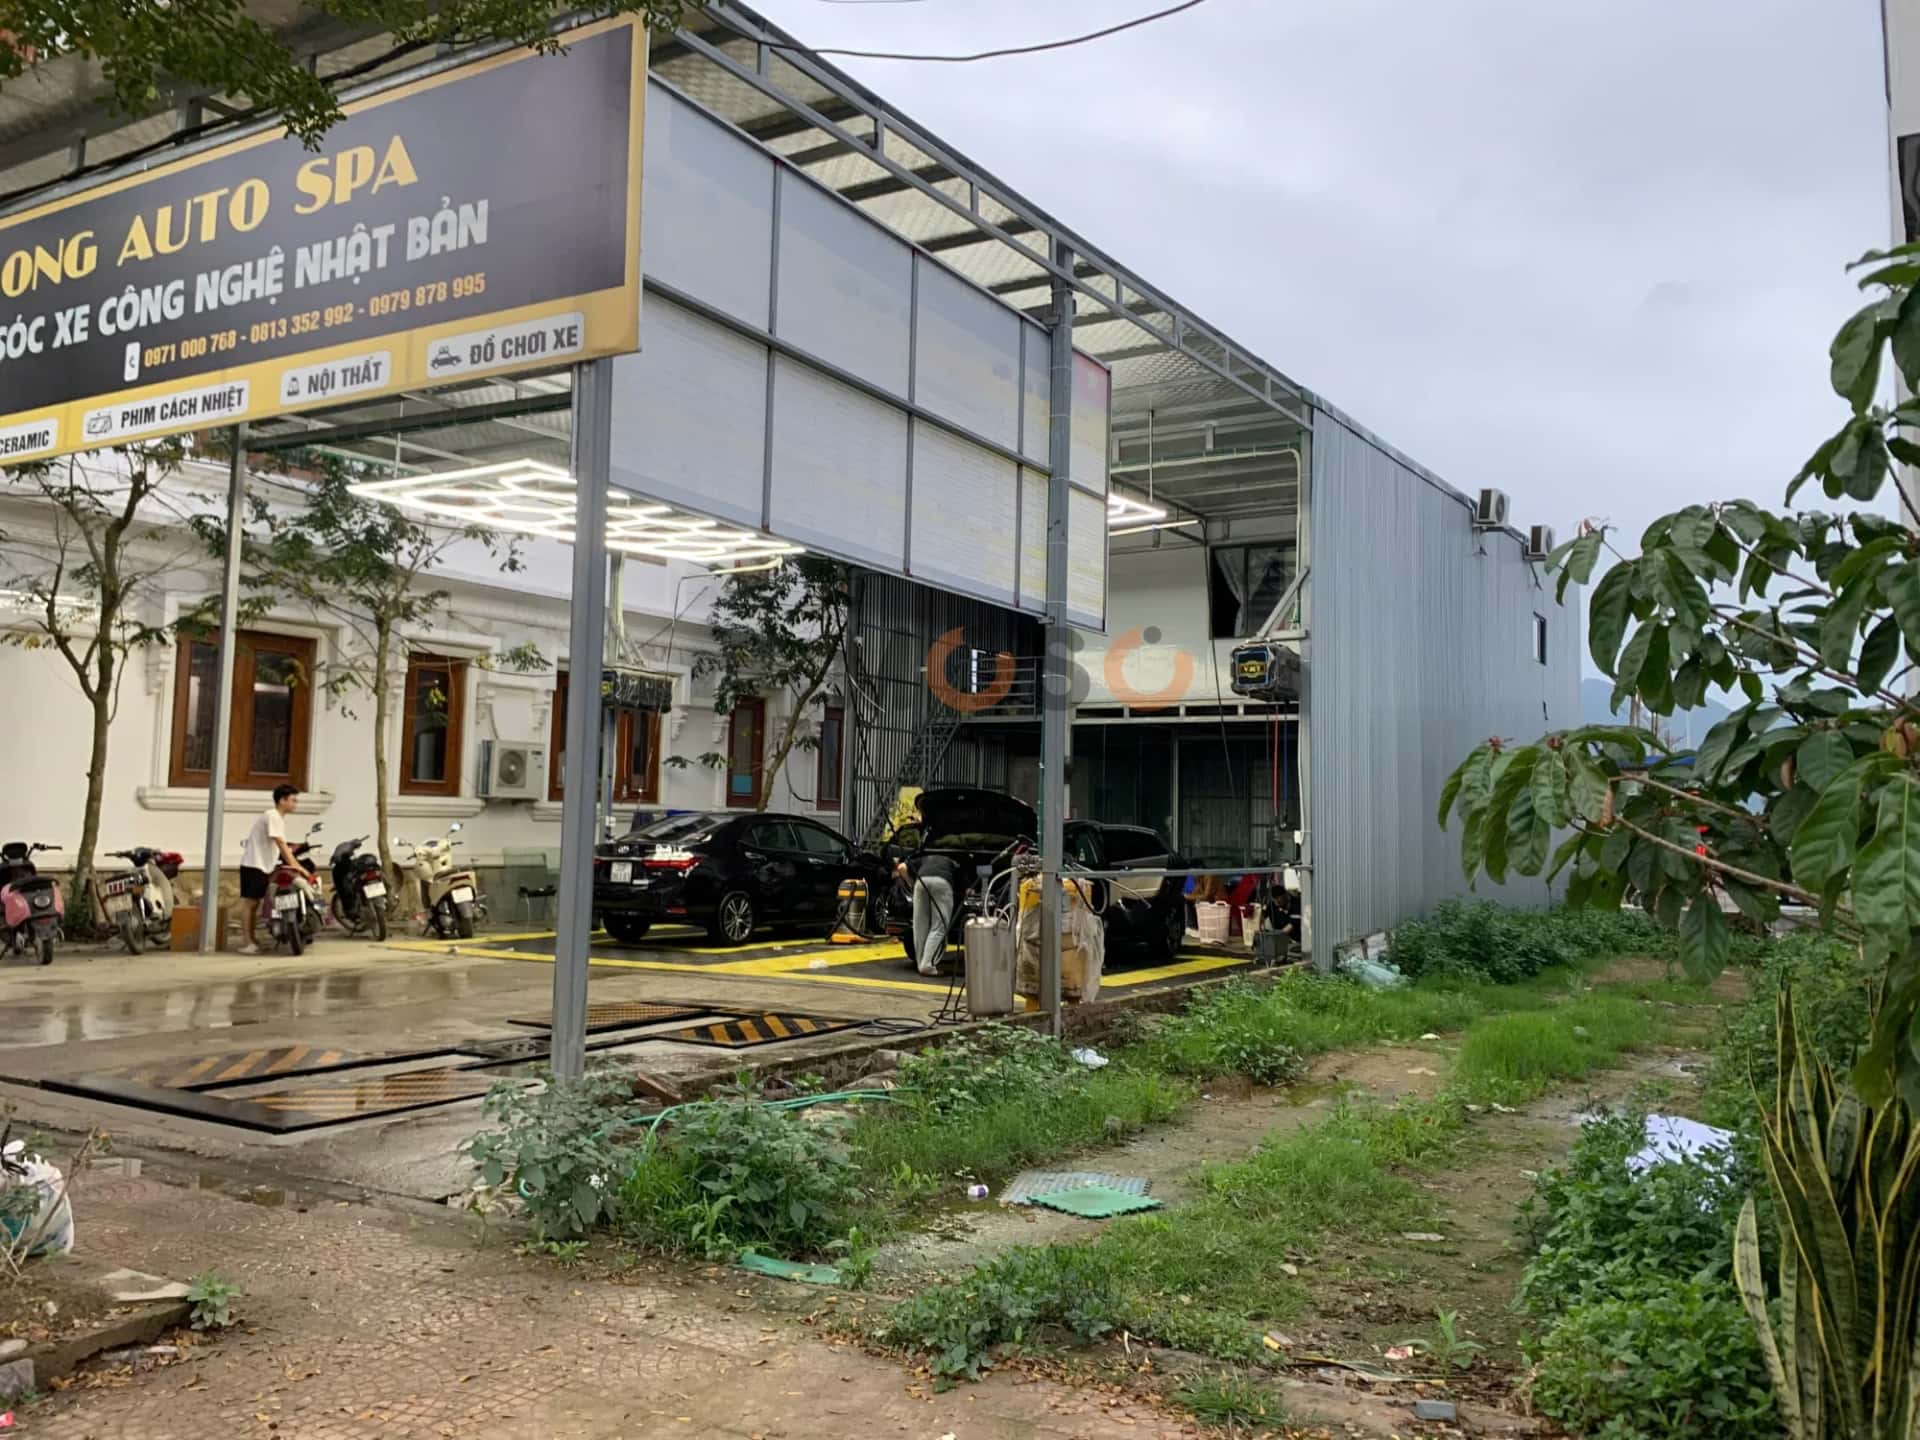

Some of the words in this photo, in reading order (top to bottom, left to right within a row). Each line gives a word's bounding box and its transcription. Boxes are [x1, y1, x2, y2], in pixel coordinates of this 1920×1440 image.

[1, 230, 98, 297] ONG
[116, 178, 270, 267] AUTO
[294, 135, 418, 214] SPA
[52, 304, 90, 348] XE
[98, 280, 184, 336] CÔNG
[194, 245, 284, 305] NGHỆ
[294, 222, 395, 288] NHẬT
[406, 196, 488, 262] BẢN
[144, 343, 176, 367] 0971
[181, 336, 206, 359] 000
[251, 320, 287, 343] 0813
[291, 311, 319, 334] 352
[324, 302, 353, 327] 992
[370, 291, 410, 316] 0979
[416, 282, 447, 306] 878
[453, 272, 485, 298] 995
[470, 335, 494, 365] ĐỒ
[553, 325, 578, 349] XE
[308, 366, 335, 396] NỘI
[341, 355, 382, 385] THẤT
[121, 406, 156, 428] PHIM
[160, 394, 197, 421] CÁCH
[202, 387, 244, 413] NHIỆT
[0, 430, 50, 456] CERAMIC
